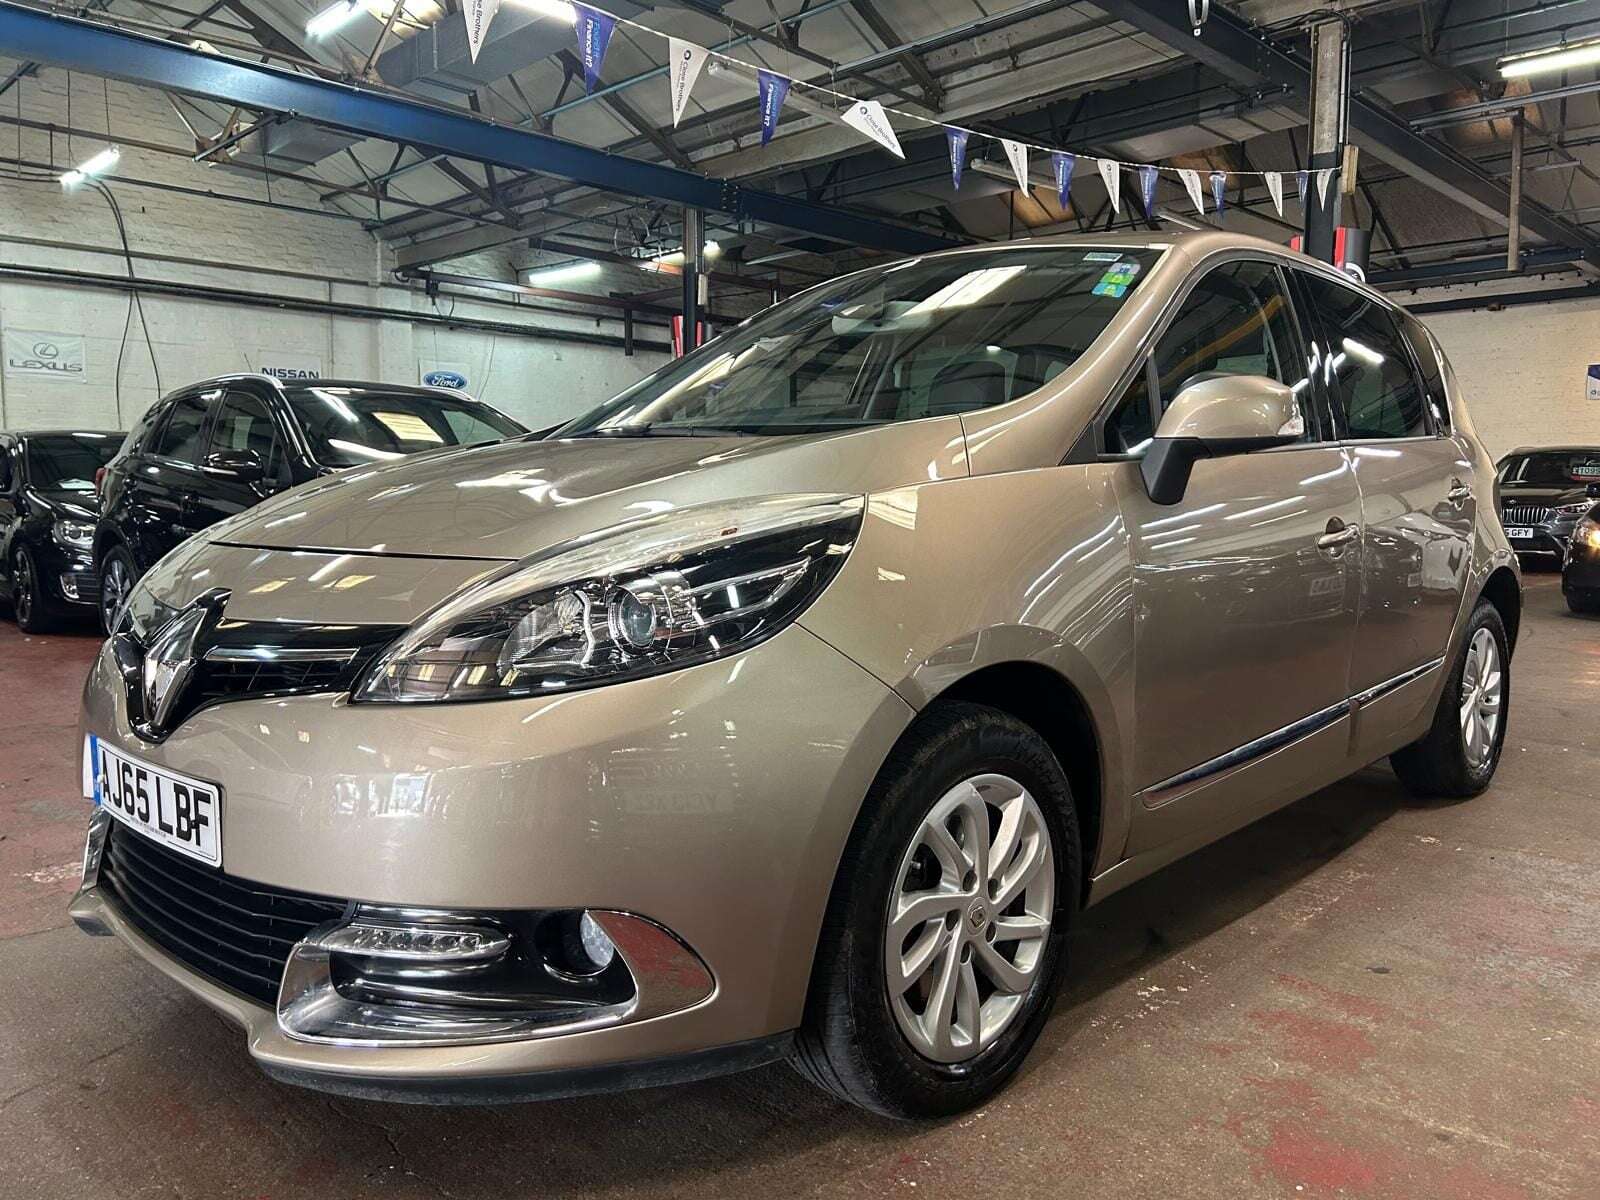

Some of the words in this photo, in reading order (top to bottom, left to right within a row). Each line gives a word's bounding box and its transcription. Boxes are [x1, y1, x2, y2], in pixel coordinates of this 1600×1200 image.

[473, 10, 483, 45] Brothers
[585, 18, 594, 54] Finance
[585, 54, 593, 68] it?
[676, 82, 685, 112] Brothers
[765, 83, 774, 114] Finance
[763, 115, 771, 127] it?
[9, 359, 83, 372] LEXUS
[262, 367, 320, 380] NISSAN
[431, 374, 460, 389] Ford
[1512, 528, 1529, 537] GFY
[103, 750, 150, 823] AJ65
[156, 775, 211, 846] LBF
